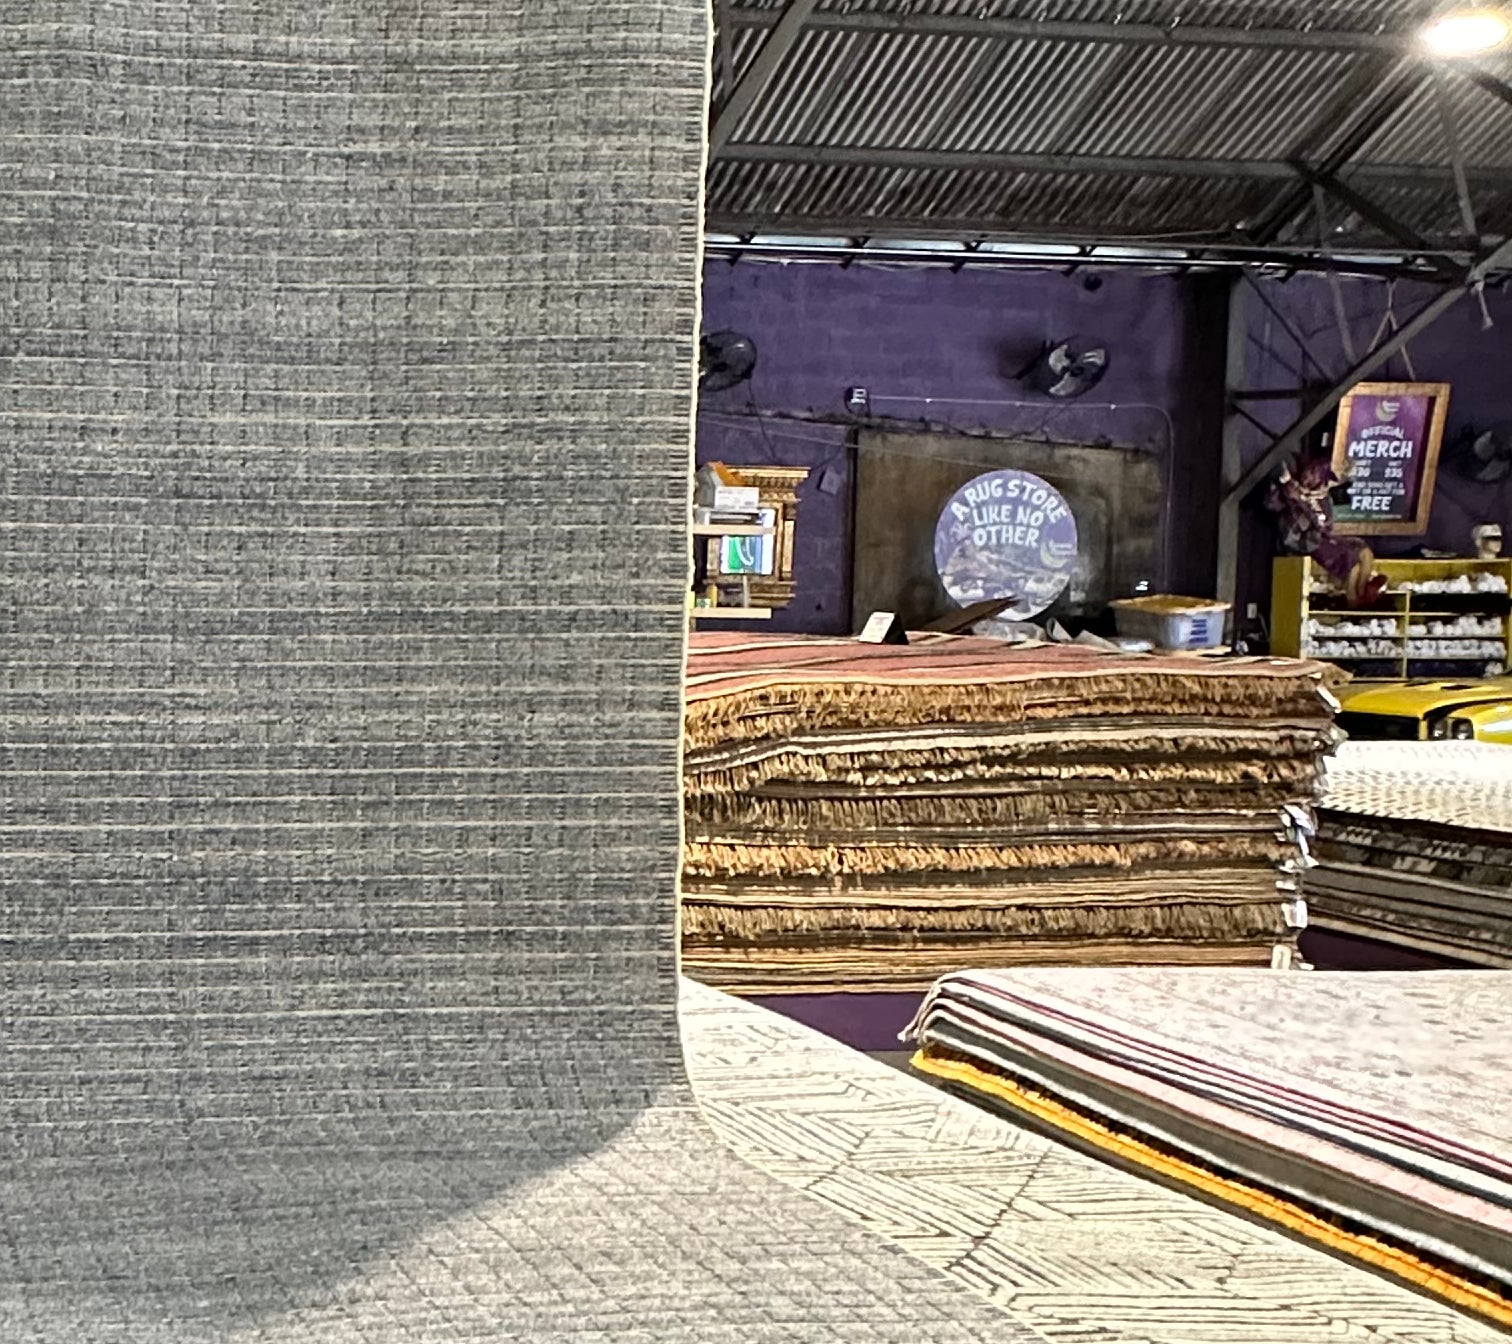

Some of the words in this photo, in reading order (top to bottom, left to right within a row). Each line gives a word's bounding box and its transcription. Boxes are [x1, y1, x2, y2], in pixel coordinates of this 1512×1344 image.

[1361, 426, 1404, 439] OFFICIAL
[1348, 440, 1413, 458] MERCH
[950, 502, 970, 521] A
[964, 478, 1004, 507] RUG
[1006, 479, 1067, 523] STORE
[1351, 496, 1392, 511] FREE
[972, 504, 1013, 526] LIKE
[1015, 506, 1044, 527] NO
[972, 524, 1040, 549] OTHER
